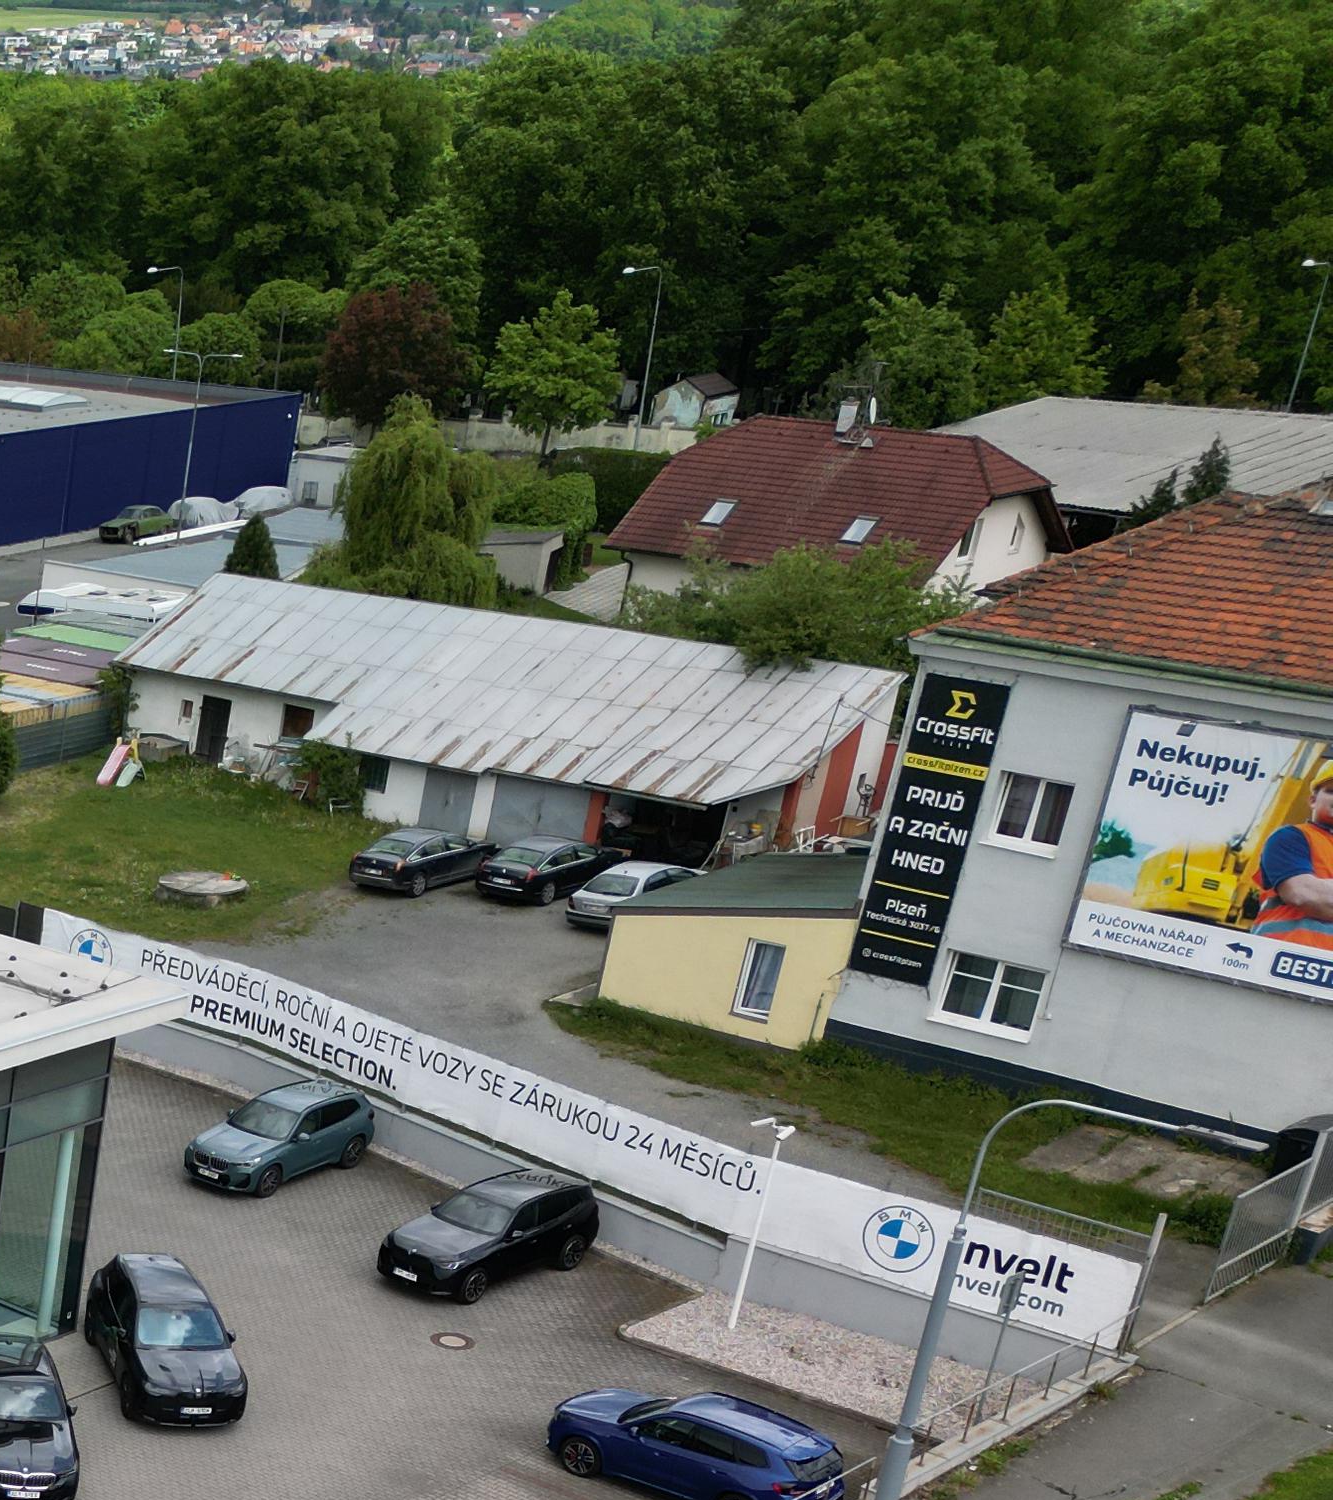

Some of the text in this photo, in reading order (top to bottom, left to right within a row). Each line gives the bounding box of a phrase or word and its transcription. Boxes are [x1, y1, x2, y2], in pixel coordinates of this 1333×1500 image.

[907, 756, 984, 777] crossfitplzen.cz
[1136, 738, 1266, 782] Nekupuj.
[1128, 768, 1230, 806] Půjčuj!
[889, 815, 968, 847] A ZAČNI
[891, 848, 945, 875] HNED
[885, 898, 927, 919] Plzeň
[1088, 912, 1208, 947] PŮJČOVNA NÁŘADÍ
[1092, 928, 1195, 958] A MECHANIZACE
[1221, 957, 1250, 971] 100m
[190, 994, 396, 1091] PREMIUM SELECTION.
[141, 949, 761, 1195] PŘEDVÁDĚCÍ, ROČNÍ A OJETÉ VOZY SE ZÁRUKOU 24 MĚSÍCŮ.
[963, 1240, 1075, 1294] nvelt
